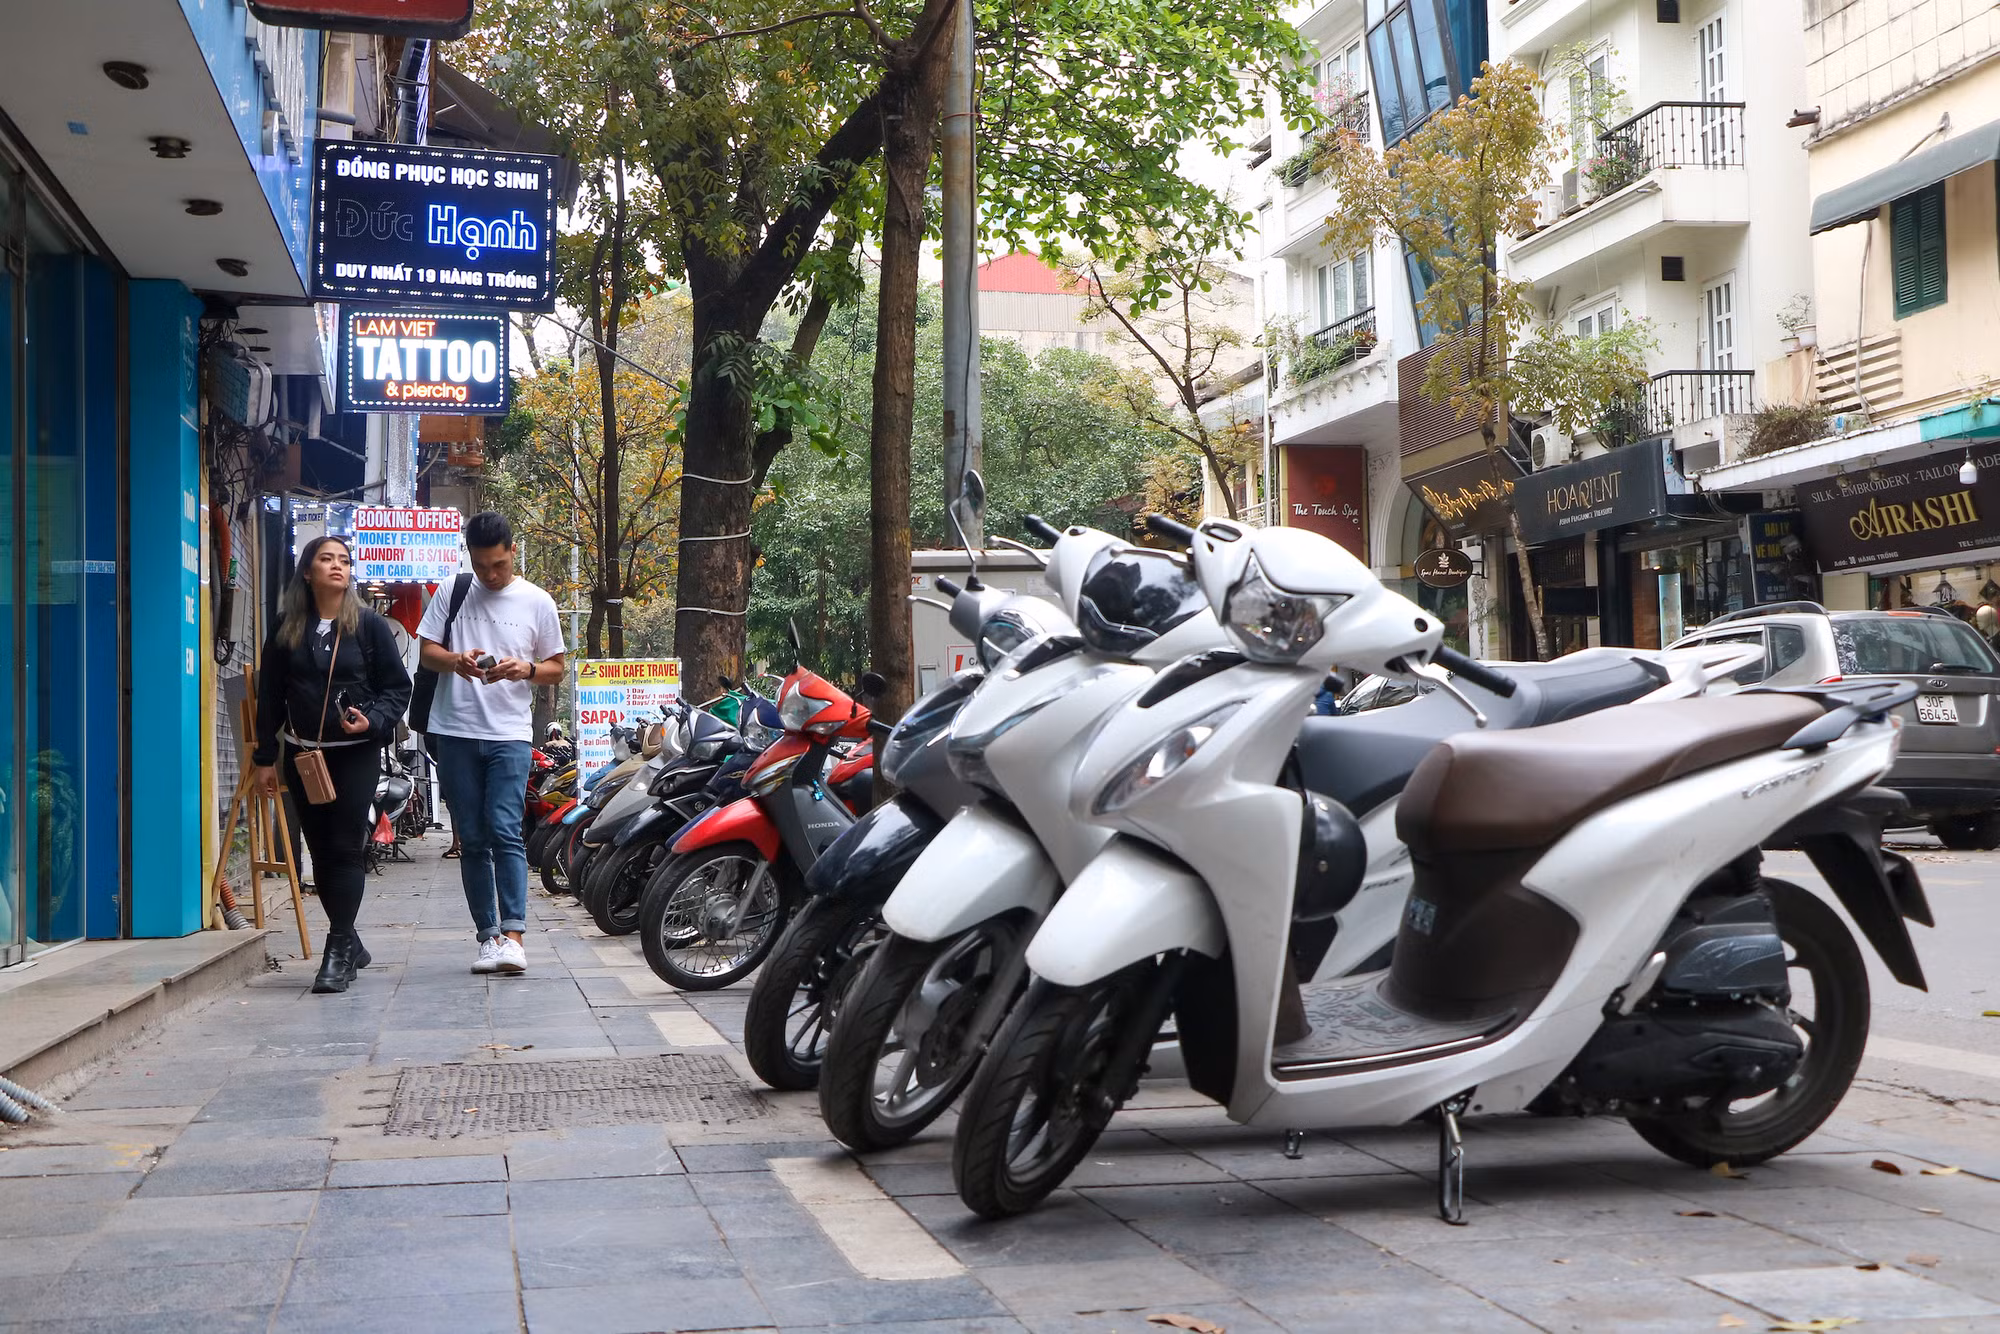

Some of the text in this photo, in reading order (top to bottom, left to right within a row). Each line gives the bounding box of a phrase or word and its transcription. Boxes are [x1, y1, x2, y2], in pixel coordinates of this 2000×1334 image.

[395, 164, 446, 186] PHỤC
[451, 167, 489, 189] HỌC
[494, 171, 539, 190] SINH
[336, 198, 537, 261] Đức Hạnh
[336, 262, 538, 290] DUY NHẤT 19 HÀNG TRỐNG
[356, 319, 436, 337] LAM VIET
[356, 337, 497, 383] TATTOO
[386, 381, 467, 402] & piercing
[1811, 489, 1835, 504] SILK
[1842, 472, 1911, 498] EMBROIDERY
[297, 513, 323, 522] BUS TICKET
[1292, 503, 1359, 519] The Touch Spa
[1850, 490, 1979, 541] AIRASHI
[358, 510, 459, 529] BOOKING OFFICE
[358, 532, 458, 546] MONEY EXCHANGE
[1958, 540, 1974, 548] TEL:
[358, 548, 458, 563] LAUNDRY 1.5 $/1KG
[1857, 554, 1876, 563] HÀNG
[366, 564, 384, 577] SIM
[387, 564, 413, 577] CARD
[416, 565, 428, 577] 4G
[438, 565, 450, 577] 5G
[599, 663, 679, 678] SINH CAFE TRAVEL
[580, 691, 618, 705] HALONG
[1925, 696, 1944, 708] 30F
[581, 710, 617, 724] SAPA
[1919, 708, 1958, 722] 564.54
[807, 821, 841, 829] HONDA
